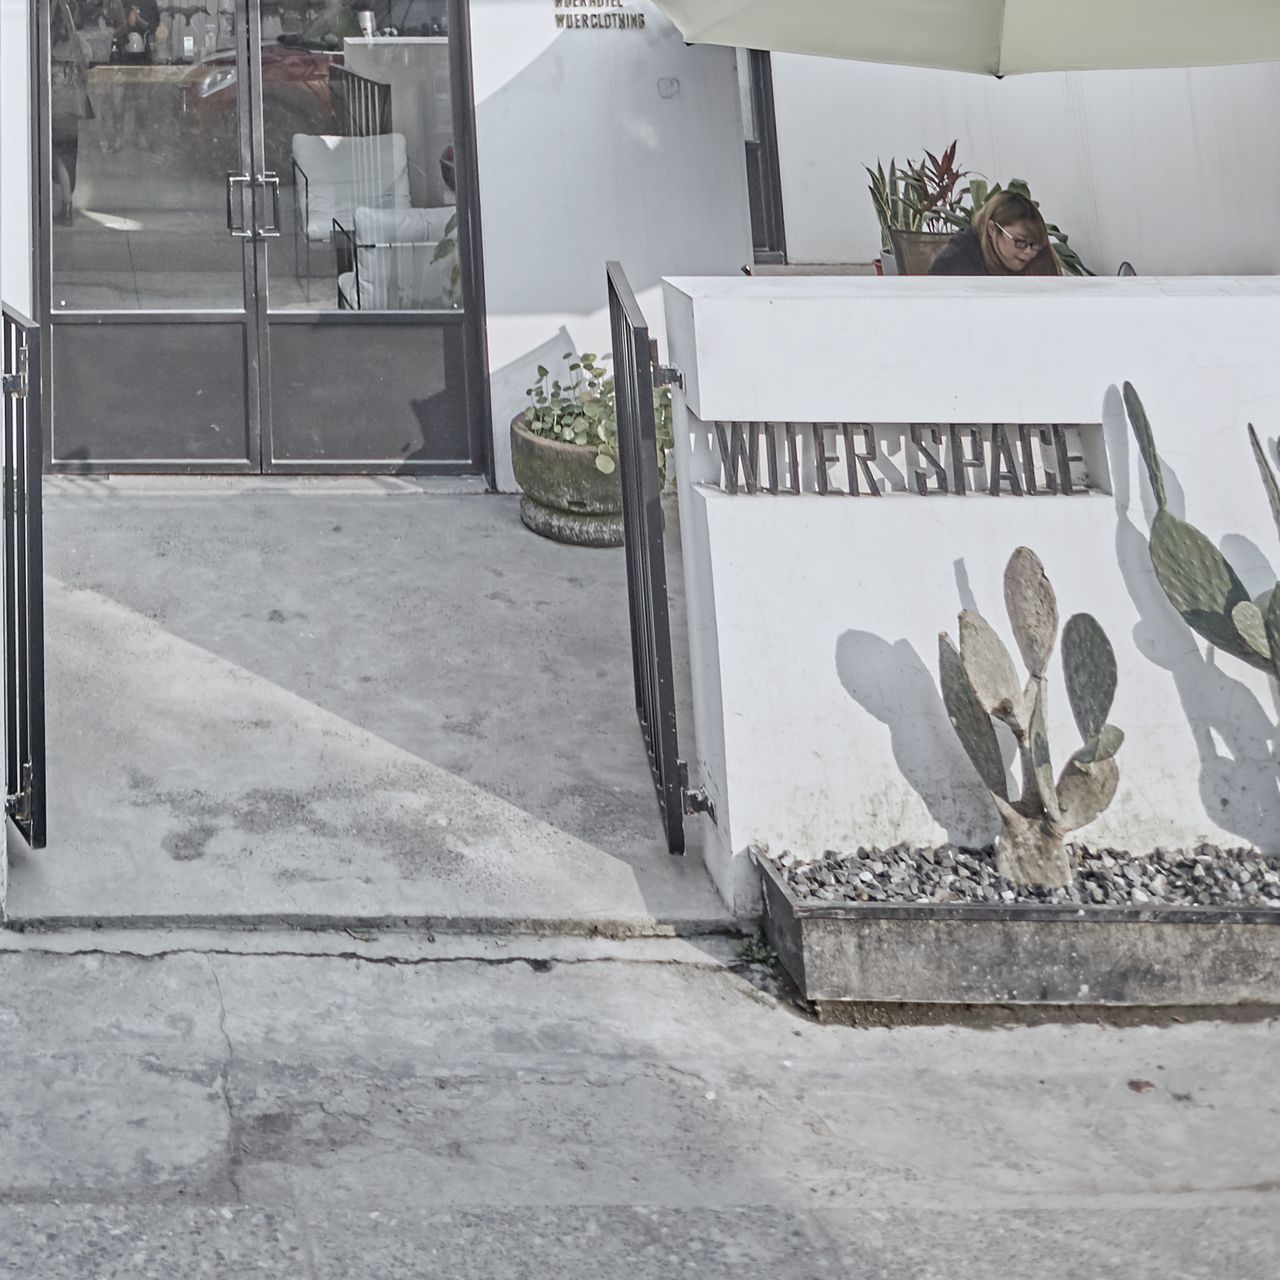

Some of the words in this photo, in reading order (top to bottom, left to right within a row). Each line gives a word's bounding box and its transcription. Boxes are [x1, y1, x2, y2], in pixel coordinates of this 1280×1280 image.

[555, 13, 589, 29] WUER
[714, 422, 882, 497] WUER
[910, 423, 1090, 497] SPACE
